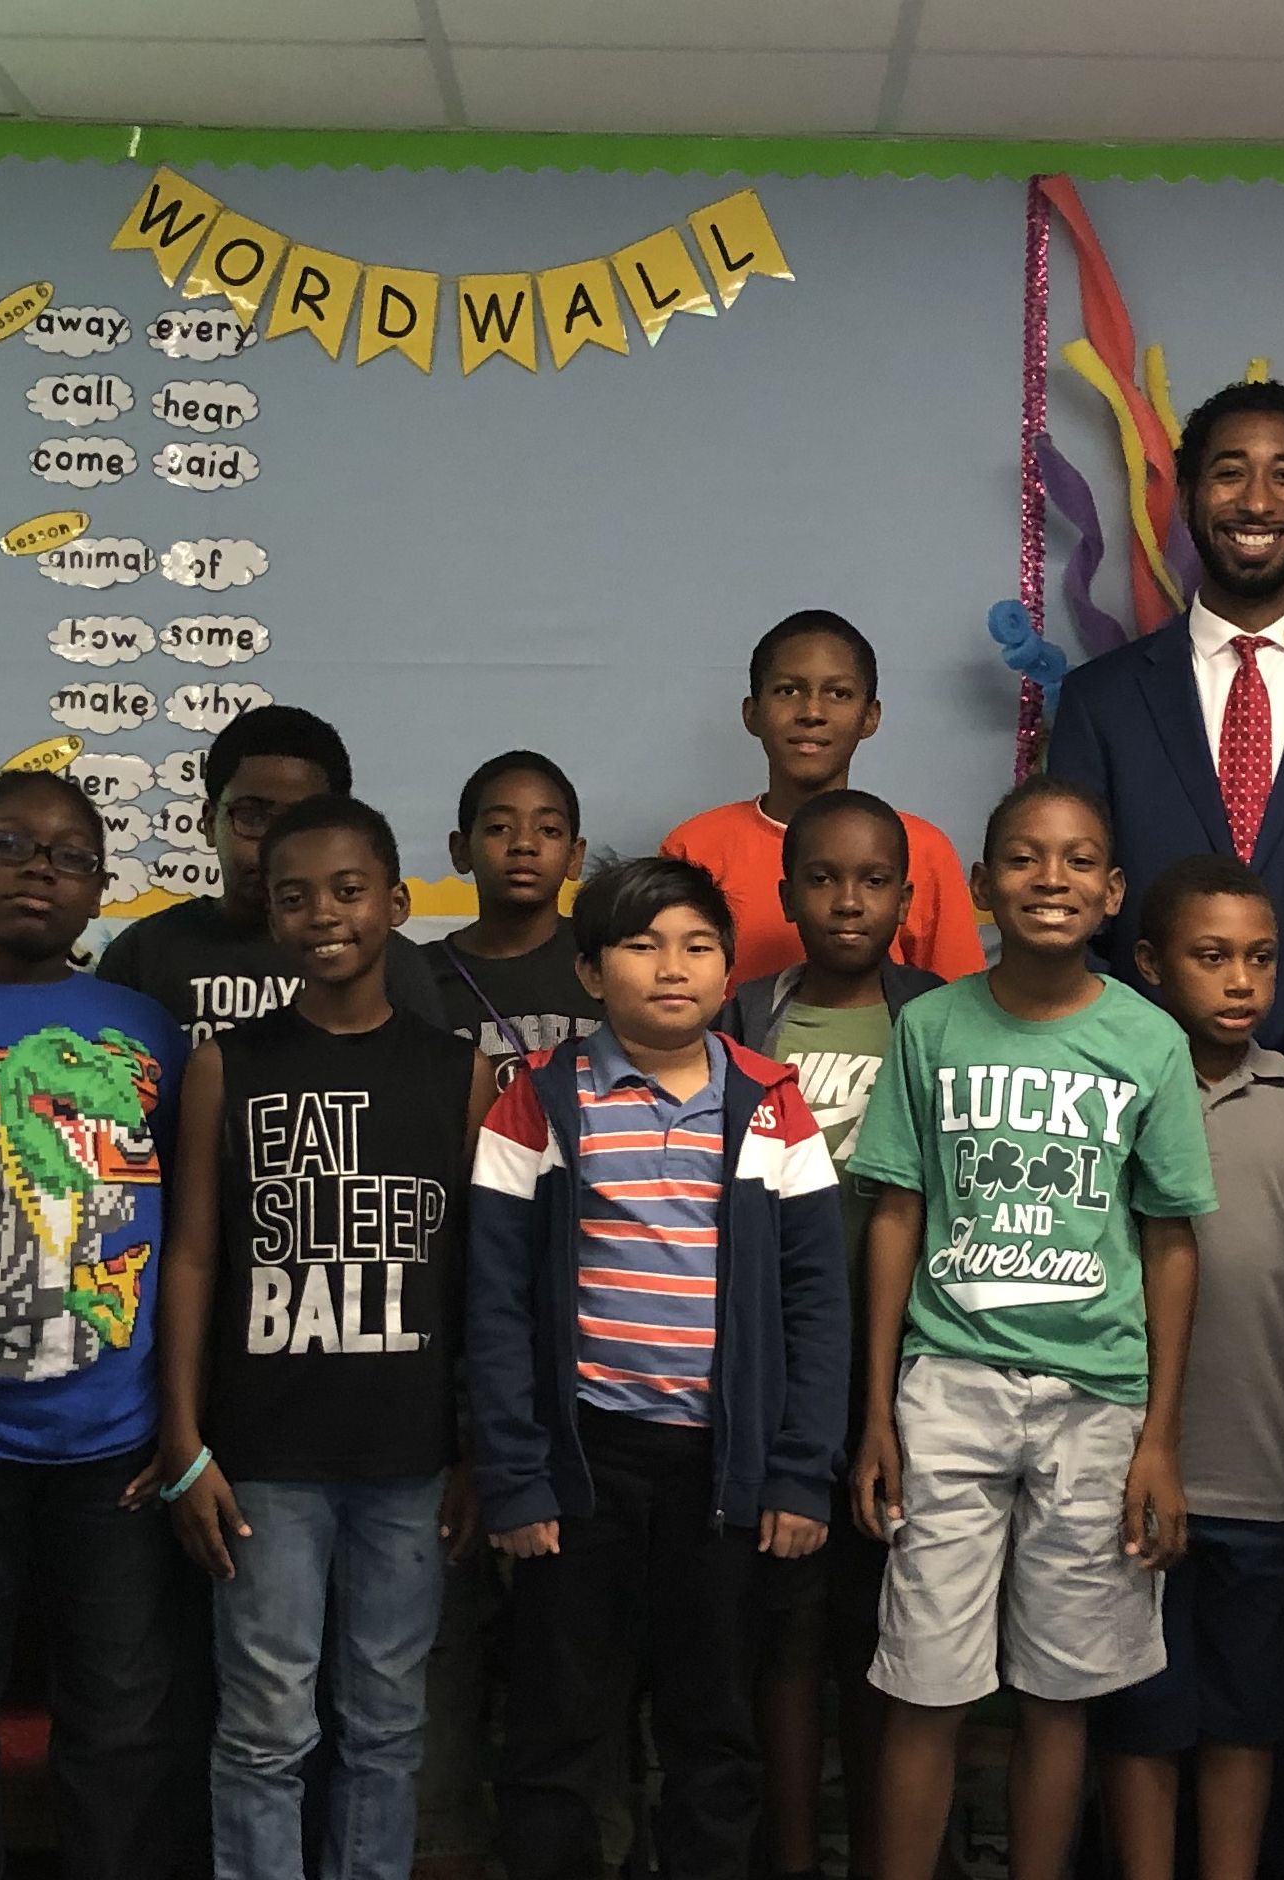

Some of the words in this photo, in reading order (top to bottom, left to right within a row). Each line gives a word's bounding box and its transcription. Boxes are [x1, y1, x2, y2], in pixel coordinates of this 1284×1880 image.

[36, 283, 50, 299] 6
[36, 313, 126, 344] away
[156, 318, 254, 351] every
[51, 379, 112, 406] call
[163, 389, 242, 425] hear
[33, 448, 123, 476] come
[168, 451, 239, 480] said
[5, 521, 70, 551] Lesson
[49, 547, 150, 571] animal
[188, 549, 222, 579] of
[70, 620, 137, 648] how
[169, 624, 254, 651] some
[58, 685, 149, 717] make
[183, 685, 253, 715] why
[190, 974, 306, 1019] TODAY'
[937, 1063, 1137, 1146] LUCKY
[248, 1091, 369, 1181] EAT
[251, 1174, 446, 1265] SLEEP
[928, 1216, 1107, 1284] Awesome
[247, 1263, 421, 1354] BALL
